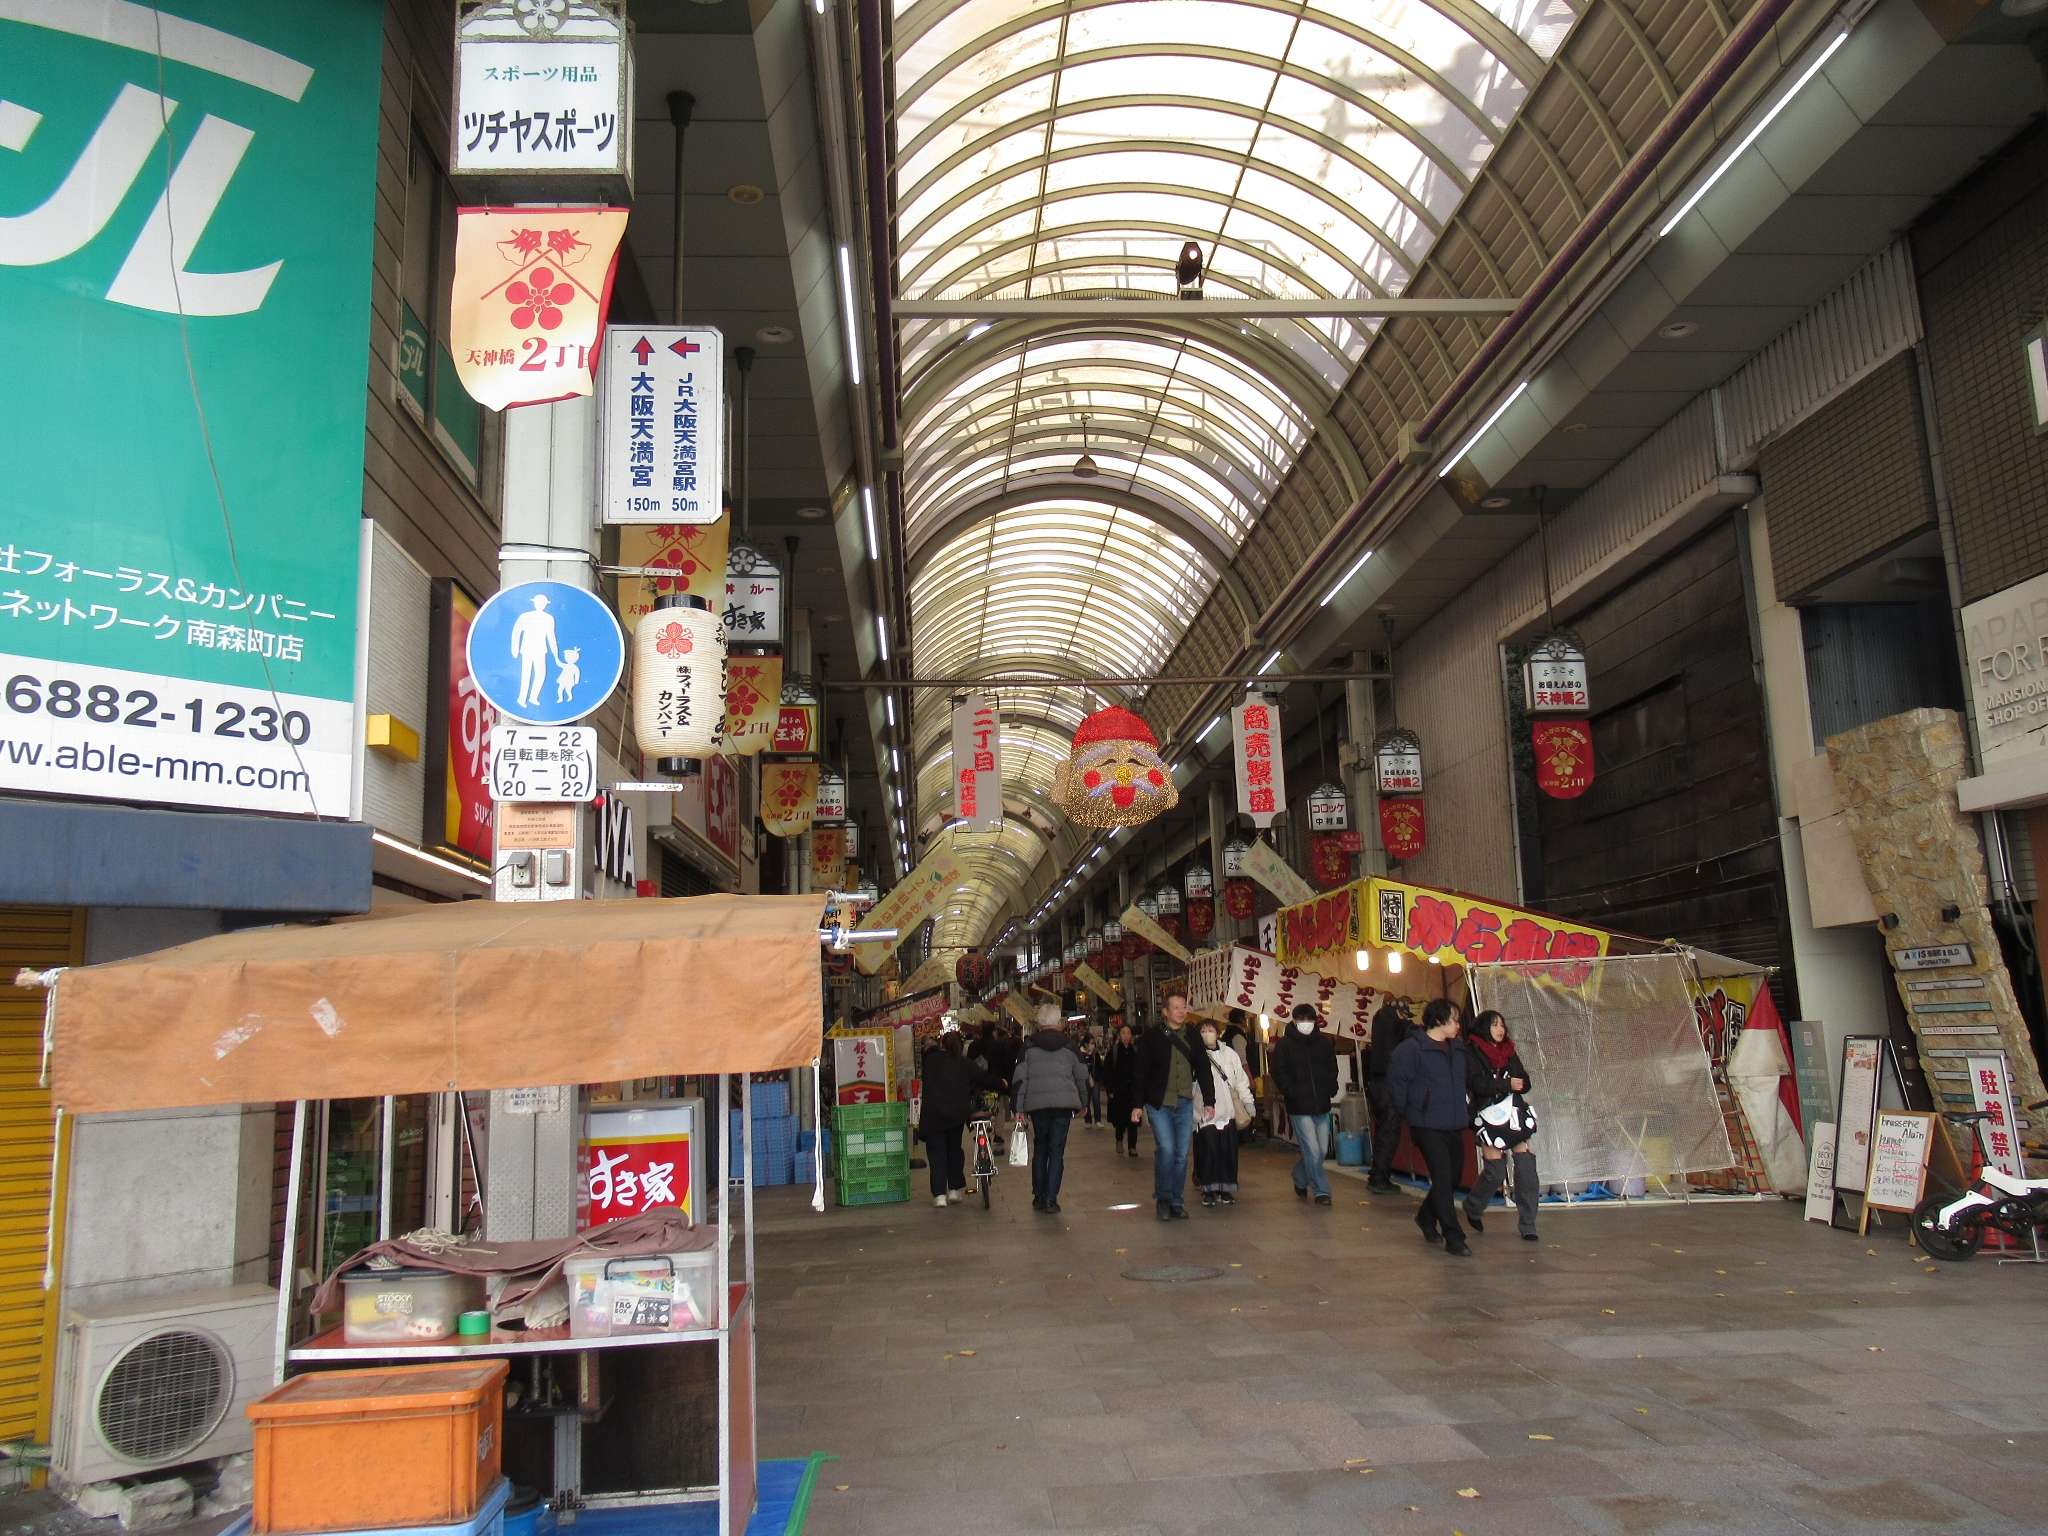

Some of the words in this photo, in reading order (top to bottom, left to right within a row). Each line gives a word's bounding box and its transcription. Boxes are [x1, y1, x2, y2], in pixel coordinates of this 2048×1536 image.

[483, 65, 598, 83] スポーツ用品
[463, 108, 616, 153] ツチヤスポーツ
[630, 371, 655, 488] 大阪天満宮
[673, 372, 698, 491] JR大阪天満宮駅
[626, 497, 661, 512] 150m
[671, 497, 698, 512] 50m
[750, 583, 774, 595] カレー
[721, 602, 766, 634] すき家
[1978, 643, 2036, 688] FOR
[657, 690, 673, 737] カンパニー
[1536, 691, 1586, 705] 天神橋2
[1985, 707, 2022, 727] SHOP
[775, 727, 806, 742] 王将
[973, 708, 994, 772] 二丁目
[503, 748, 585, 762] 自転車を除く
[1243, 704, 1276, 813] 商売繁盛
[1312, 803, 1345, 814] コロッケ
[1406, 894, 1599, 987] からあげ
[590, 1150, 676, 1213] すき家
